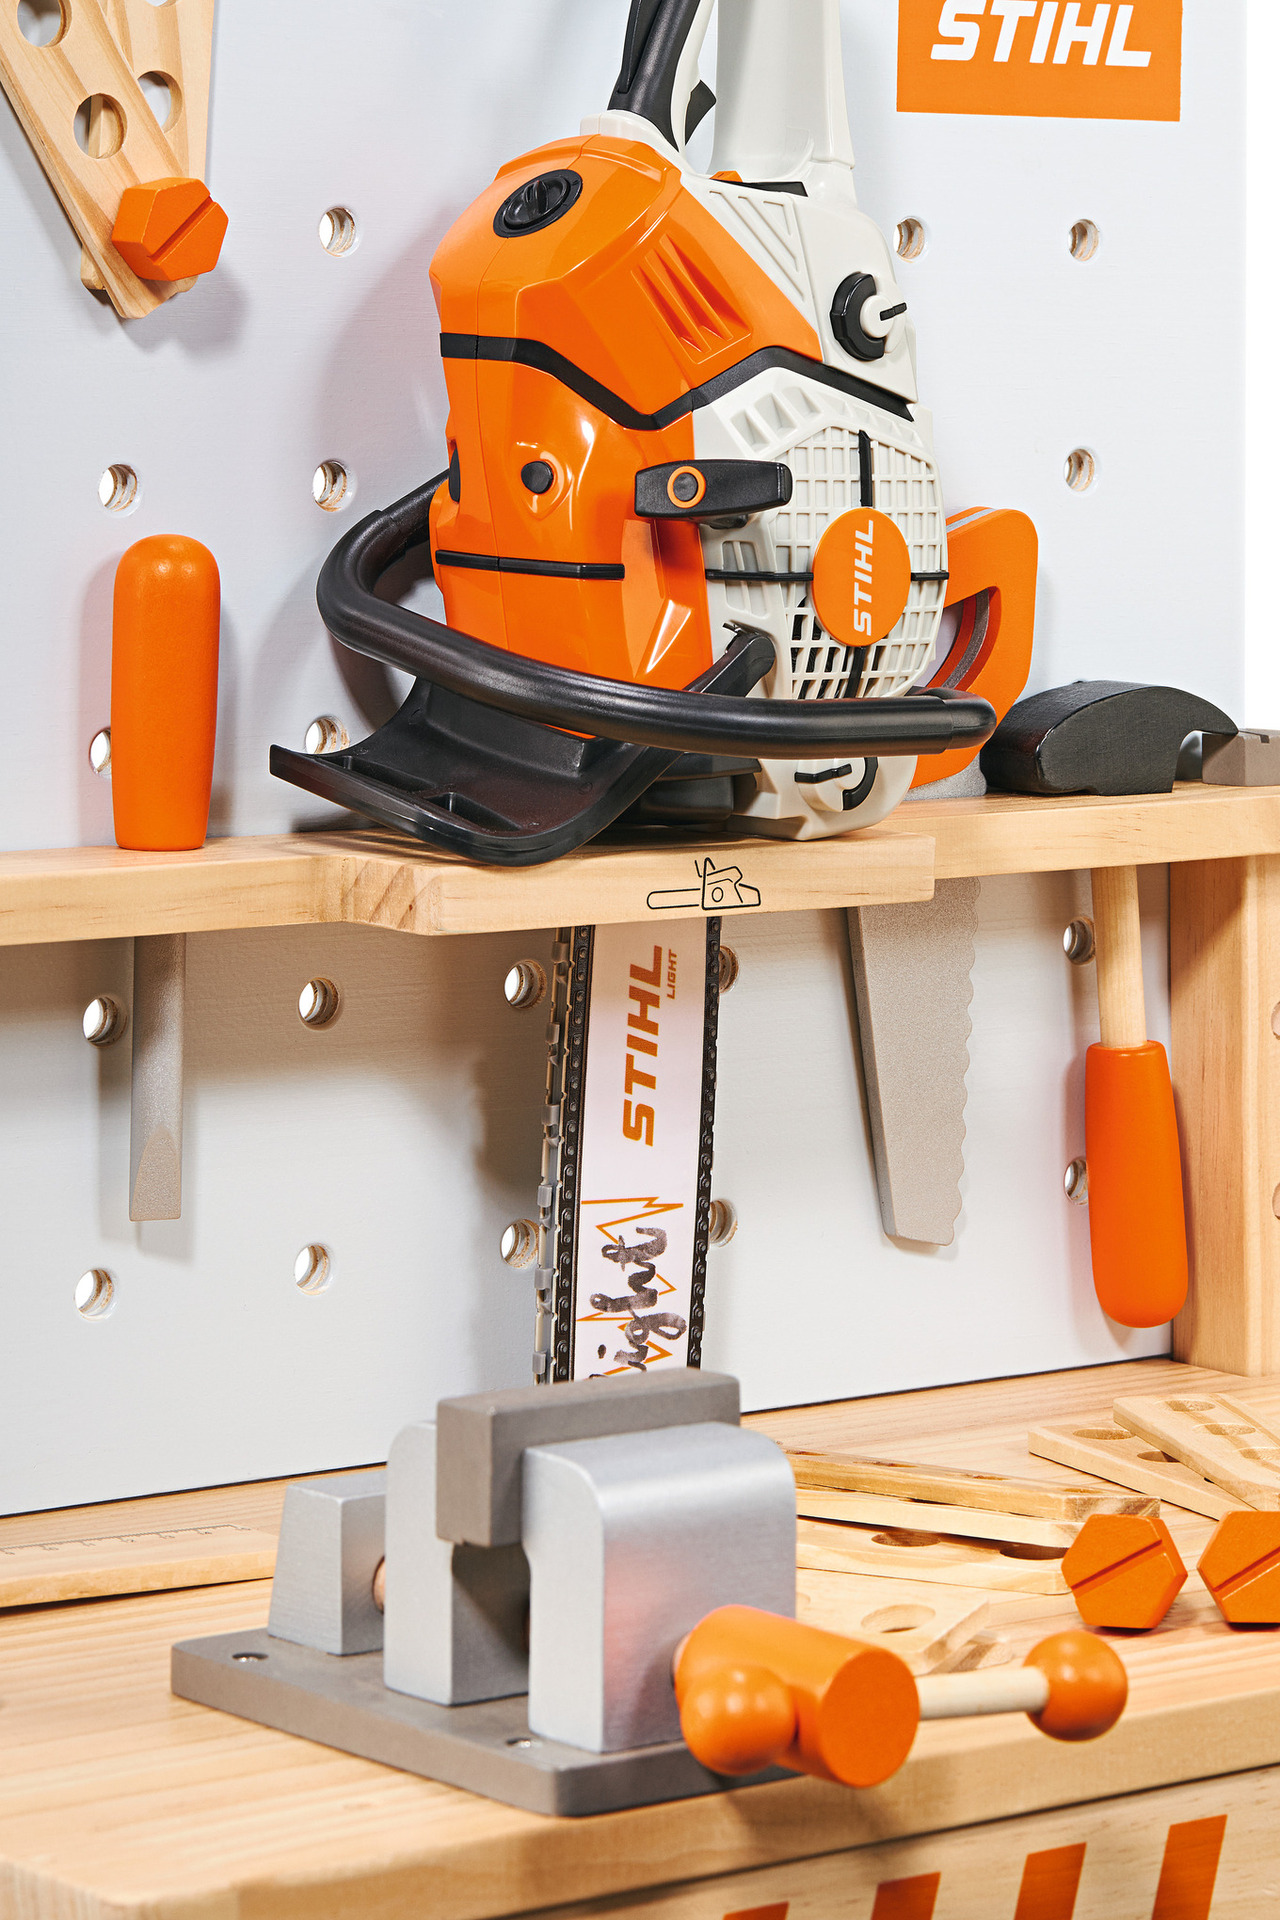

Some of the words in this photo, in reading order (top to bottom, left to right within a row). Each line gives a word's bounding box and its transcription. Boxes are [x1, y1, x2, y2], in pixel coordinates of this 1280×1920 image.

[930, 0, 1152, 68] STIHL
[853, 519, 874, 636] STIHL
[666, 948, 678, 1000] LIGHT
[622, 944, 663, 1147] STIHL
[589, 1226, 687, 1378] ight
